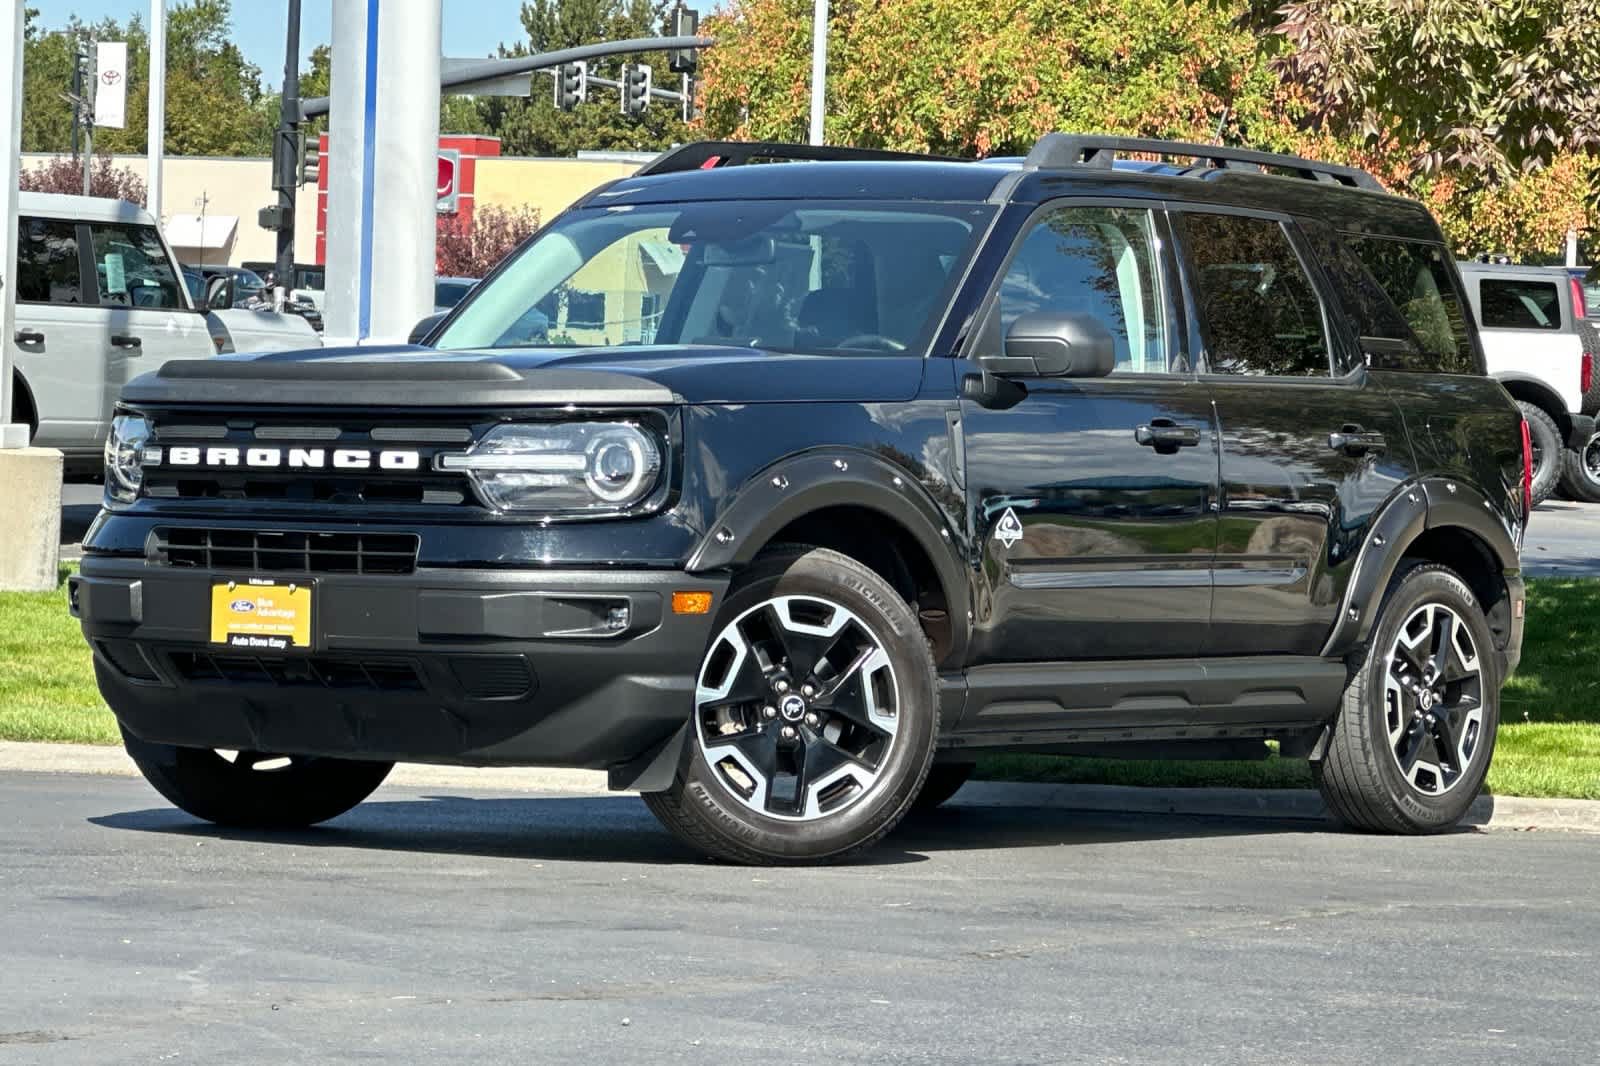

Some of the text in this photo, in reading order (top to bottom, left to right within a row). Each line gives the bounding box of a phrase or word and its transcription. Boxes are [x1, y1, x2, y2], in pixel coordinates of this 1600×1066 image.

[169, 447, 420, 469] BRONCO
[232, 636, 249, 646] Auto
[268, 637, 287, 650] Easy
